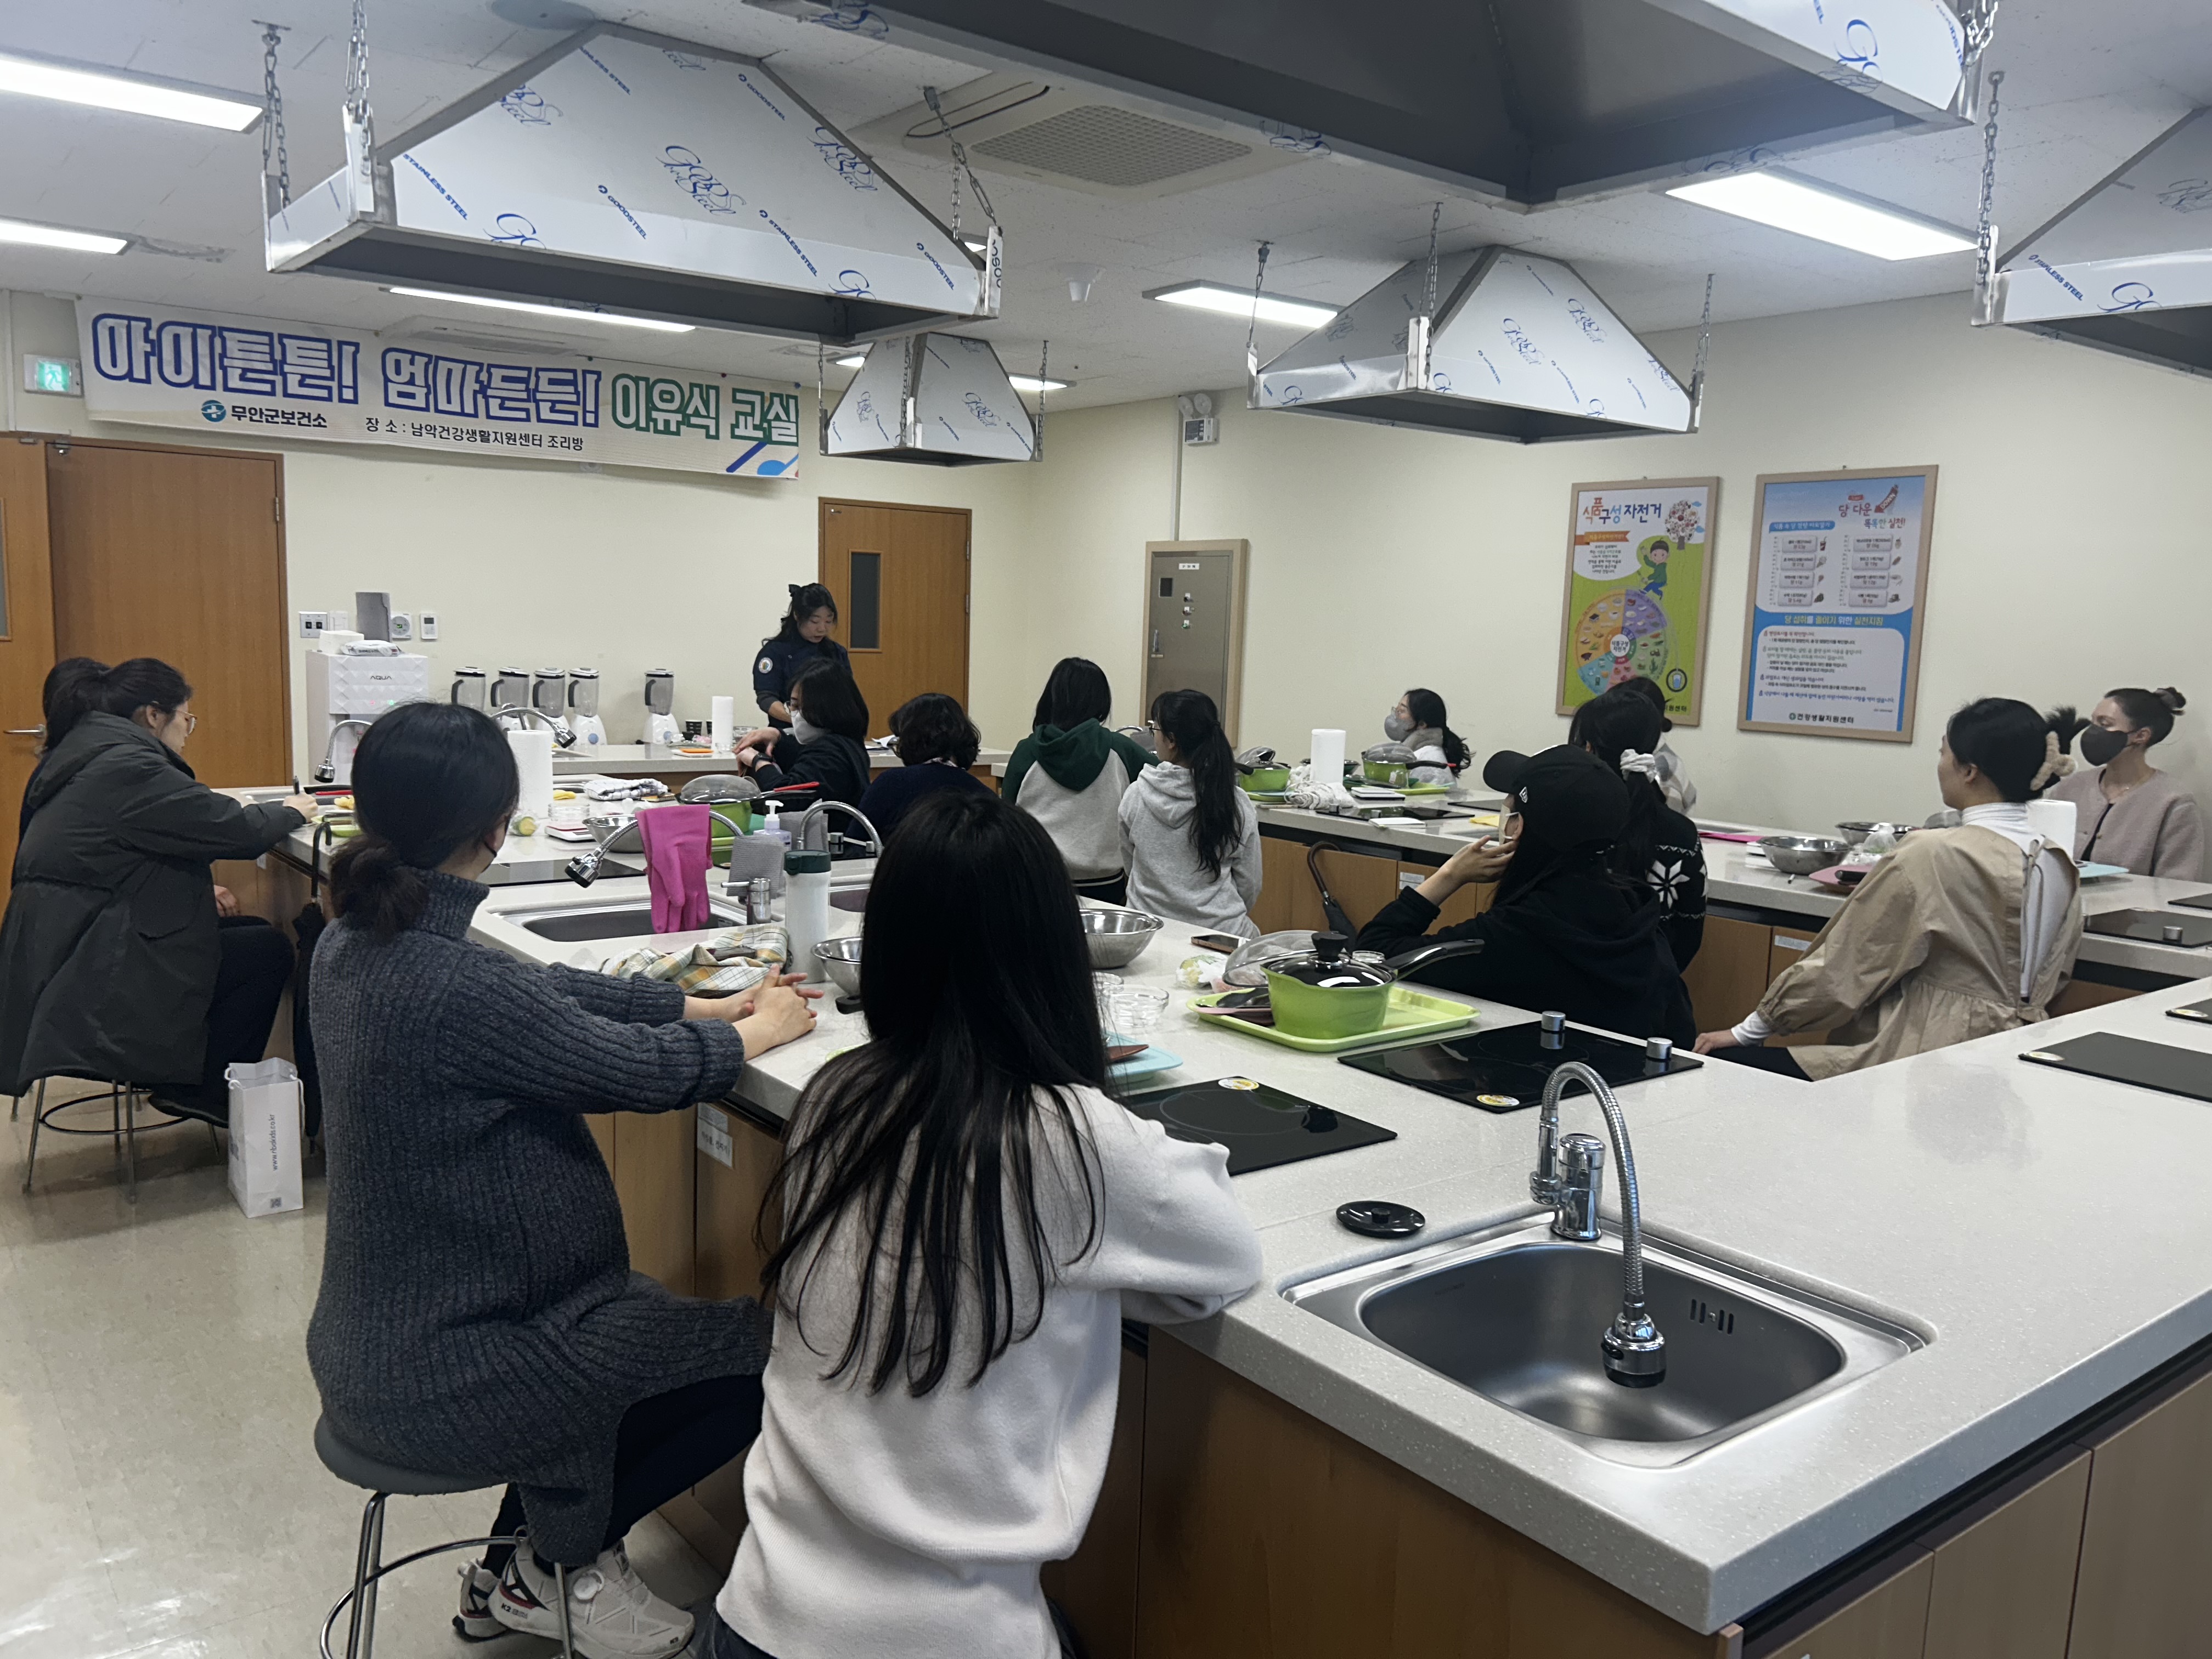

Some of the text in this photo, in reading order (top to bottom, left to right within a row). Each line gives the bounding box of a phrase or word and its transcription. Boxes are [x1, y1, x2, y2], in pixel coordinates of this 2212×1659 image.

[608, 73, 631, 95] STEEL
[746, 82, 786, 121] GOODSTEEL
[403, 153, 468, 221] STAINLESS STEEL
[607, 195, 646, 240] GOODSTEEL
[768, 219, 818, 277] STAINLESS STEEL
[923, 251, 955, 291] GOODSTEEL
[2034, 259, 2064, 283] STAINLESS
[2063, 281, 2084, 301] STEEL
[92, 313, 360, 404] 아이튼튼!
[381, 347, 602, 428] 엄마든든!
[611, 373, 720, 441] 이유식
[730, 387, 799, 447] 교실
[1263, 383, 1273, 397] STEEL
[231, 405, 328, 428] 무안군보건소
[411, 422, 543, 448] 남악건강생활지원센터
[547, 435, 583, 451] 조리방
[1583, 497, 1662, 525] 식품구성 자전거
[1838, 503, 1872, 517] 당 다운
[1880, 493, 1896, 509] DOWN
[1864, 518, 1886, 529] 똑똑한
[501, 1602, 511, 1612] K2
